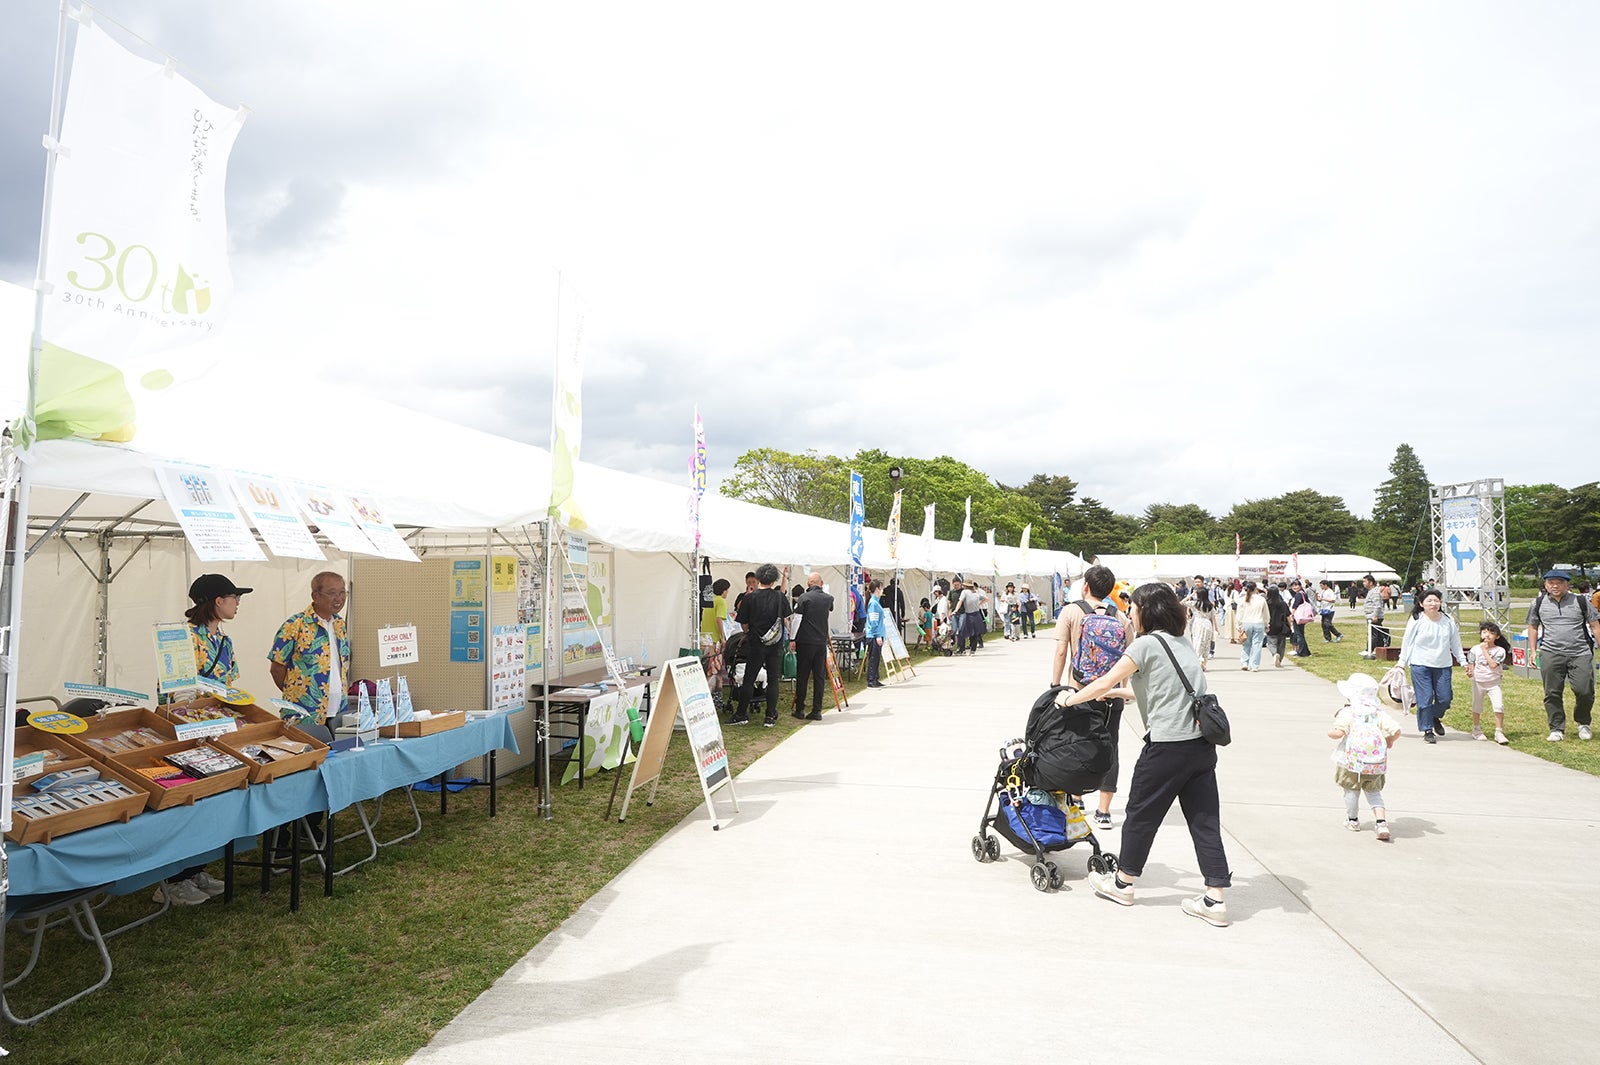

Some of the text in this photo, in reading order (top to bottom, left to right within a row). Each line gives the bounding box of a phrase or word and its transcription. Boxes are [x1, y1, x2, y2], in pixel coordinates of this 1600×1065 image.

[62, 291, 214, 332] 30th Anniversary
[853, 480, 864, 537] 東海村
[1447, 520, 1476, 529] ネモフィラ
[383, 632, 412, 642] CASH ONLY
